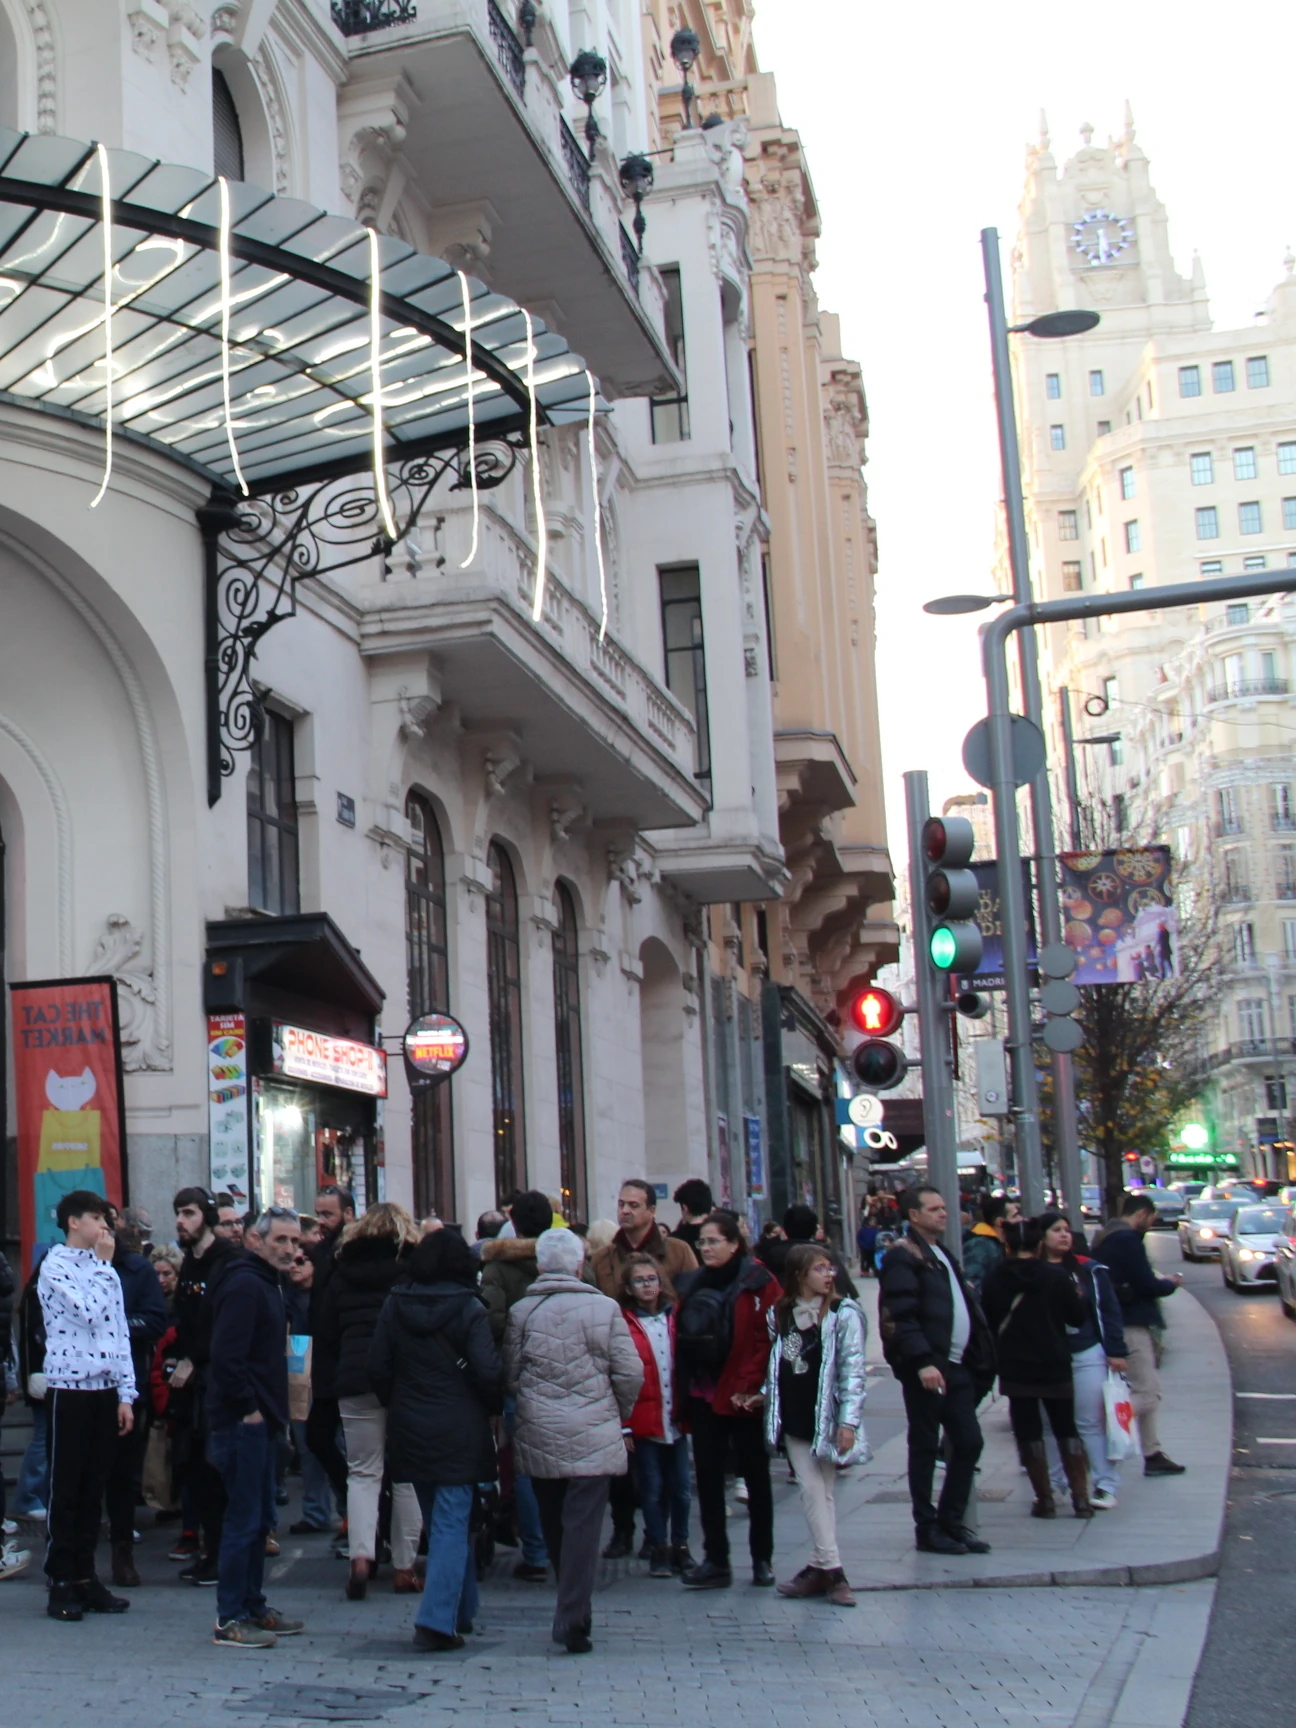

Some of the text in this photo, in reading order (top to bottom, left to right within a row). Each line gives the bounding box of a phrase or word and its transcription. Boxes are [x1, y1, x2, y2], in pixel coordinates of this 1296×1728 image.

[972, 977, 1005, 988] MADRI
[288, 1029, 329, 1060] PHONE
[415, 1047, 454, 1059] NETFLIX
